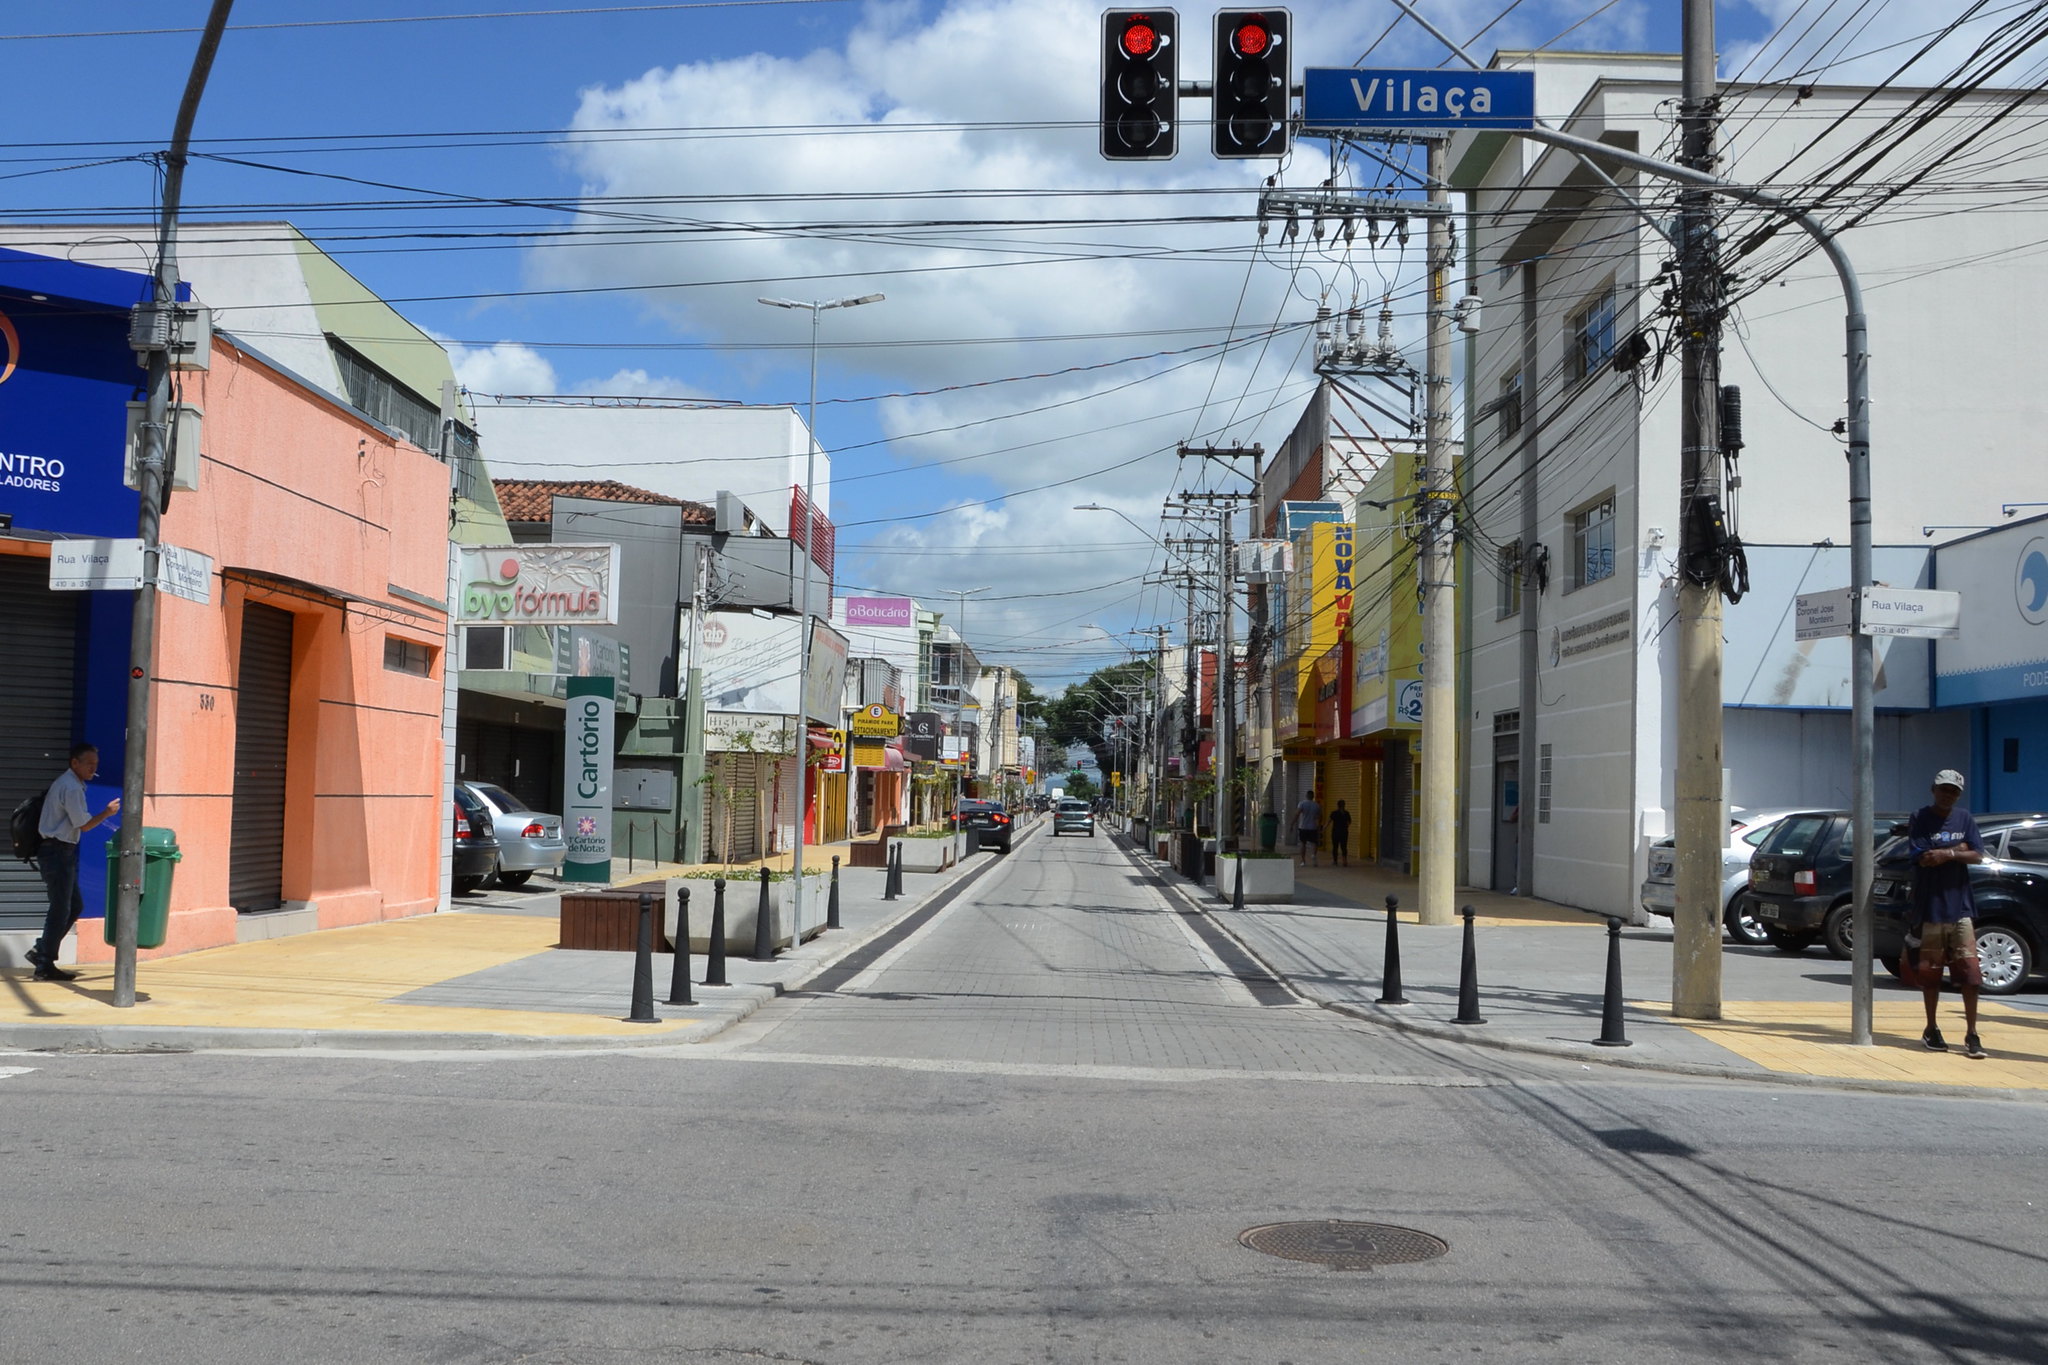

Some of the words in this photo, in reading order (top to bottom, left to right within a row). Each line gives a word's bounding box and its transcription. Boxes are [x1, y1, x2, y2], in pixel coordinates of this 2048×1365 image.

[1350, 78, 1492, 118] Vilaça
[166, 548, 178, 559] Rua
[1334, 526, 1353, 590] NOVA
[57, 554, 76, 564] Rua
[82, 554, 110, 567] Vilaça
[188, 566, 203, 578] José
[55, 579, 67, 588] 410
[80, 579, 92, 588] 310
[178, 573, 202, 588] Monteiro
[1796, 599, 1808, 607] Rua
[1871, 600, 1891, 610] Rua
[1894, 602, 1924, 613] Vilaça
[1796, 606, 1819, 616] Coronel
[1820, 605, 1834, 614] José
[1808, 615, 1834, 624] Monteiro
[854, 726, 897, 734] ESTACIONAMENTO
[577, 701, 600, 799] Cartório
[574, 836, 606, 845] Cartório
[568, 844, 580, 852] de
[580, 844, 606, 853] Notas
